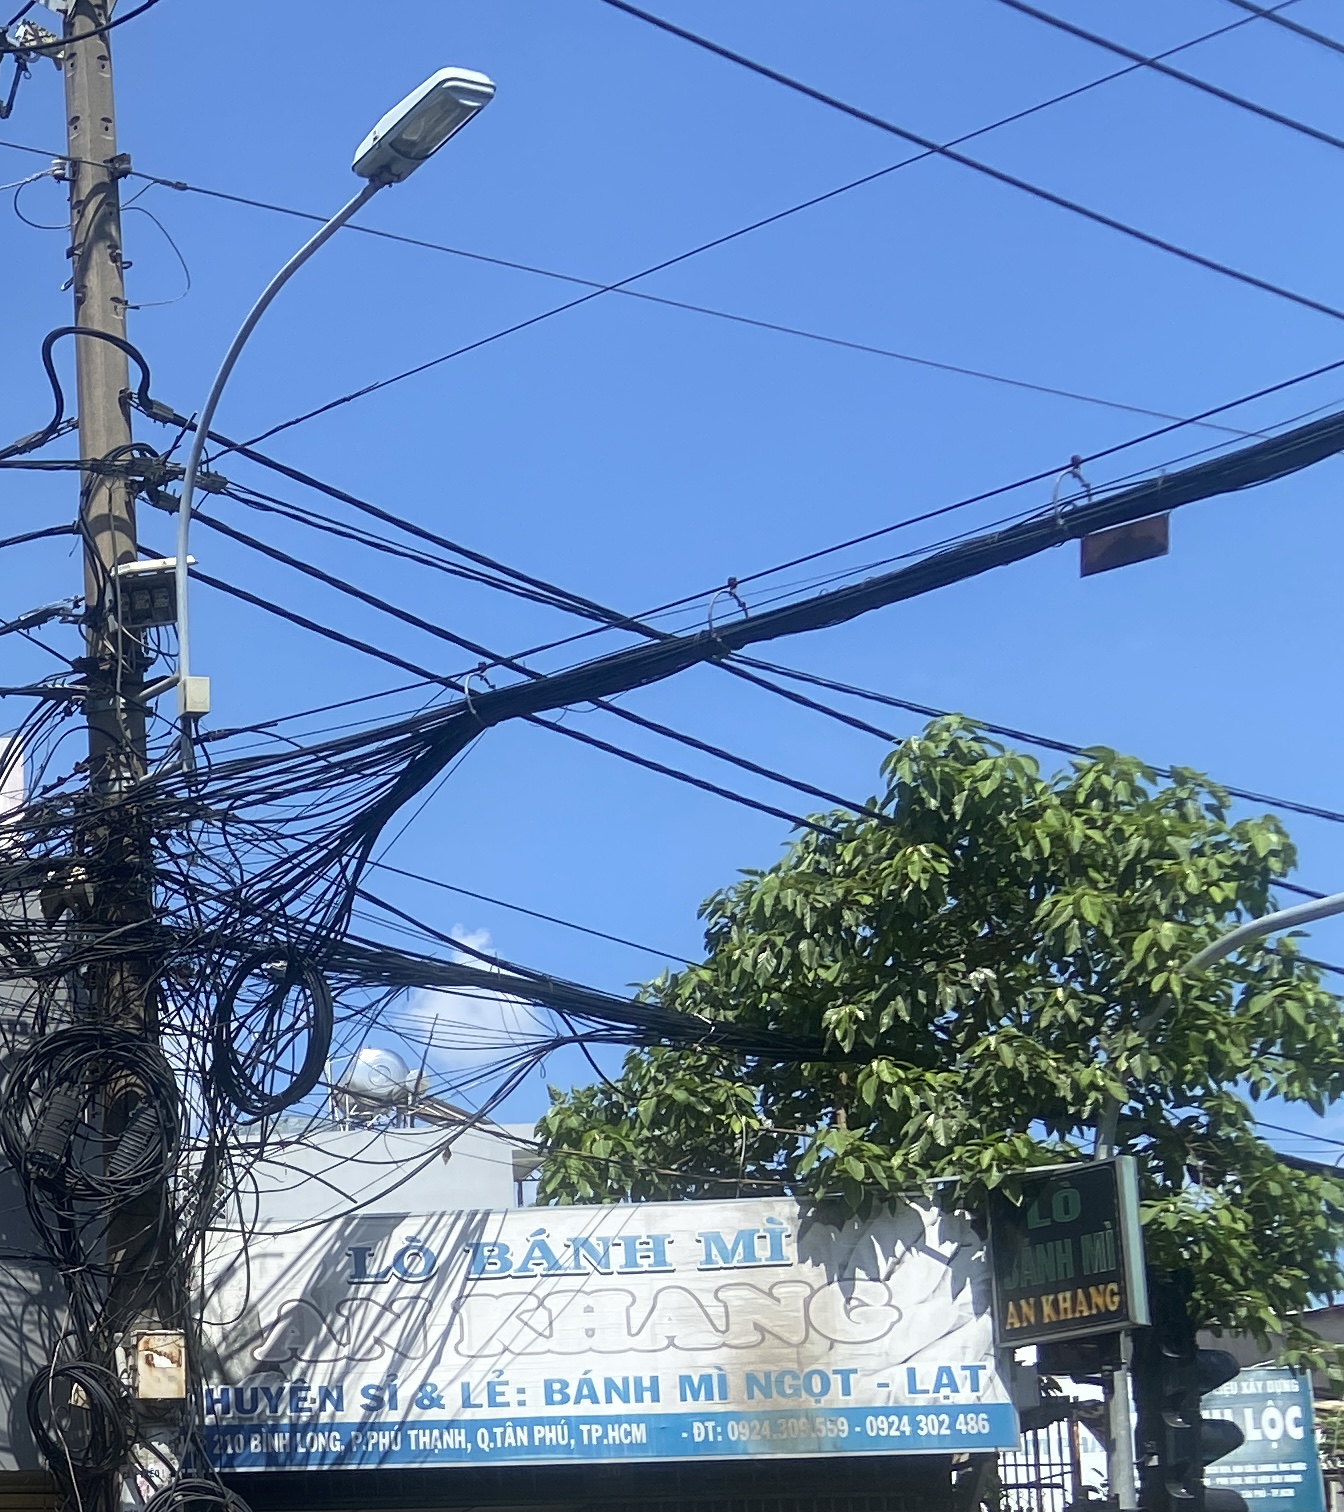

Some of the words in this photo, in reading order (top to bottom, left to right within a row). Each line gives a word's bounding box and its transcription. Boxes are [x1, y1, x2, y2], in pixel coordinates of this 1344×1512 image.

[345, 1235, 439, 1284] LÒ
[463, 1227, 676, 1281] BÁNH
[696, 1216, 793, 1271] MÌ
[451, 1278, 903, 1358] KHANG
[1005, 1297, 1036, 1330] AN
[1041, 1282, 1121, 1324] KHANG
[204, 1377, 345, 1415] HUYÊN
[360, 1374, 399, 1413] SỈ
[415, 1382, 446, 1411] &
[461, 1368, 527, 1409] LẺ:
[543, 1370, 660, 1406] BÁNH
[679, 1366, 730, 1403] MÌ
[746, 1368, 859, 1405] NGỌT
[906, 1364, 988, 1403] LẠT
[1241, 1378, 1263, 1394] XÂY
[213, 1433, 244, 1454] 210
[250, 1428, 290, 1453] BÌNH
[408, 1428, 472, 1454] THẠNH,
[533, 1417, 576, 1450] PHÚ,
[579, 1422, 647, 1446] TP.HCM
[693, 1421, 723, 1444] ĐT:
[727, 1416, 849, 1442] 0924.309.559
[865, 1415, 911, 1437] 0924
[915, 1414, 950, 1436] 302
[955, 1413, 990, 1435] 486
[1243, 1399, 1305, 1450] LỘC
